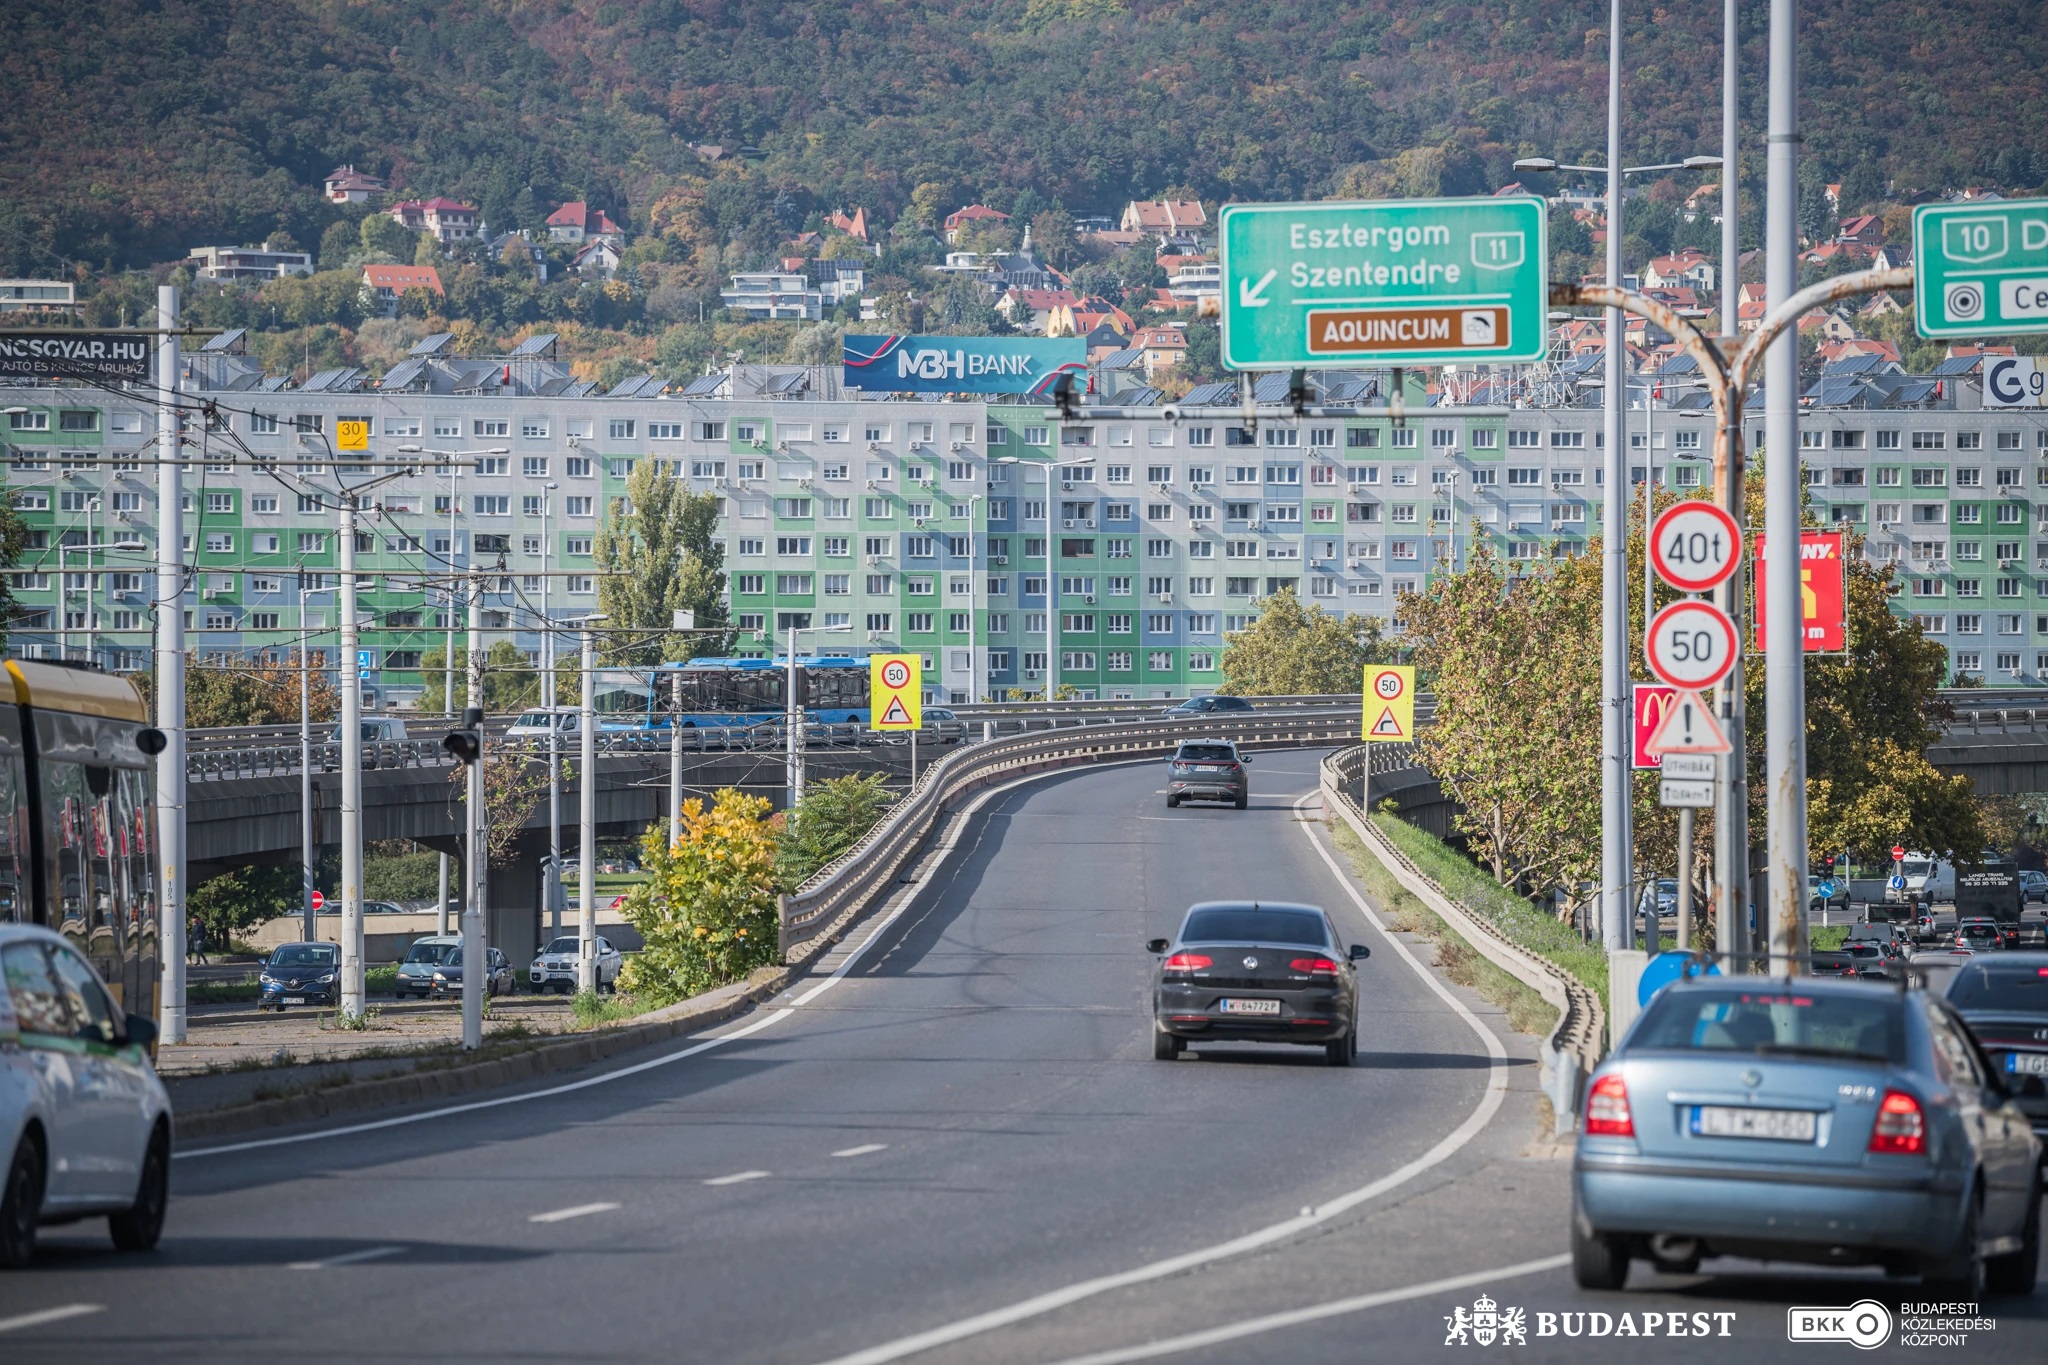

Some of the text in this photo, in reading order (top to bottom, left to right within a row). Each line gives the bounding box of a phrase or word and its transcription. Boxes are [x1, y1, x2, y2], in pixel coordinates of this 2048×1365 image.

[1289, 222, 1450, 252] Esztergom
[1489, 238, 1507, 261] 11
[1961, 224, 1990, 252] 10
[1290, 258, 1461, 288] Szentendre
[1323, 317, 1450, 344] AQUINCUM
[2, 360, 32, 372] AJTÓ
[34, 360, 49, 372] ÉS
[898, 349, 1033, 379] MBH BANK
[342, 422, 360, 436] 30
[1668, 532, 1721, 564] 40t
[1672, 631, 1711, 662] 50
[889, 669, 904, 681] 50
[1382, 680, 1397, 692] 50
